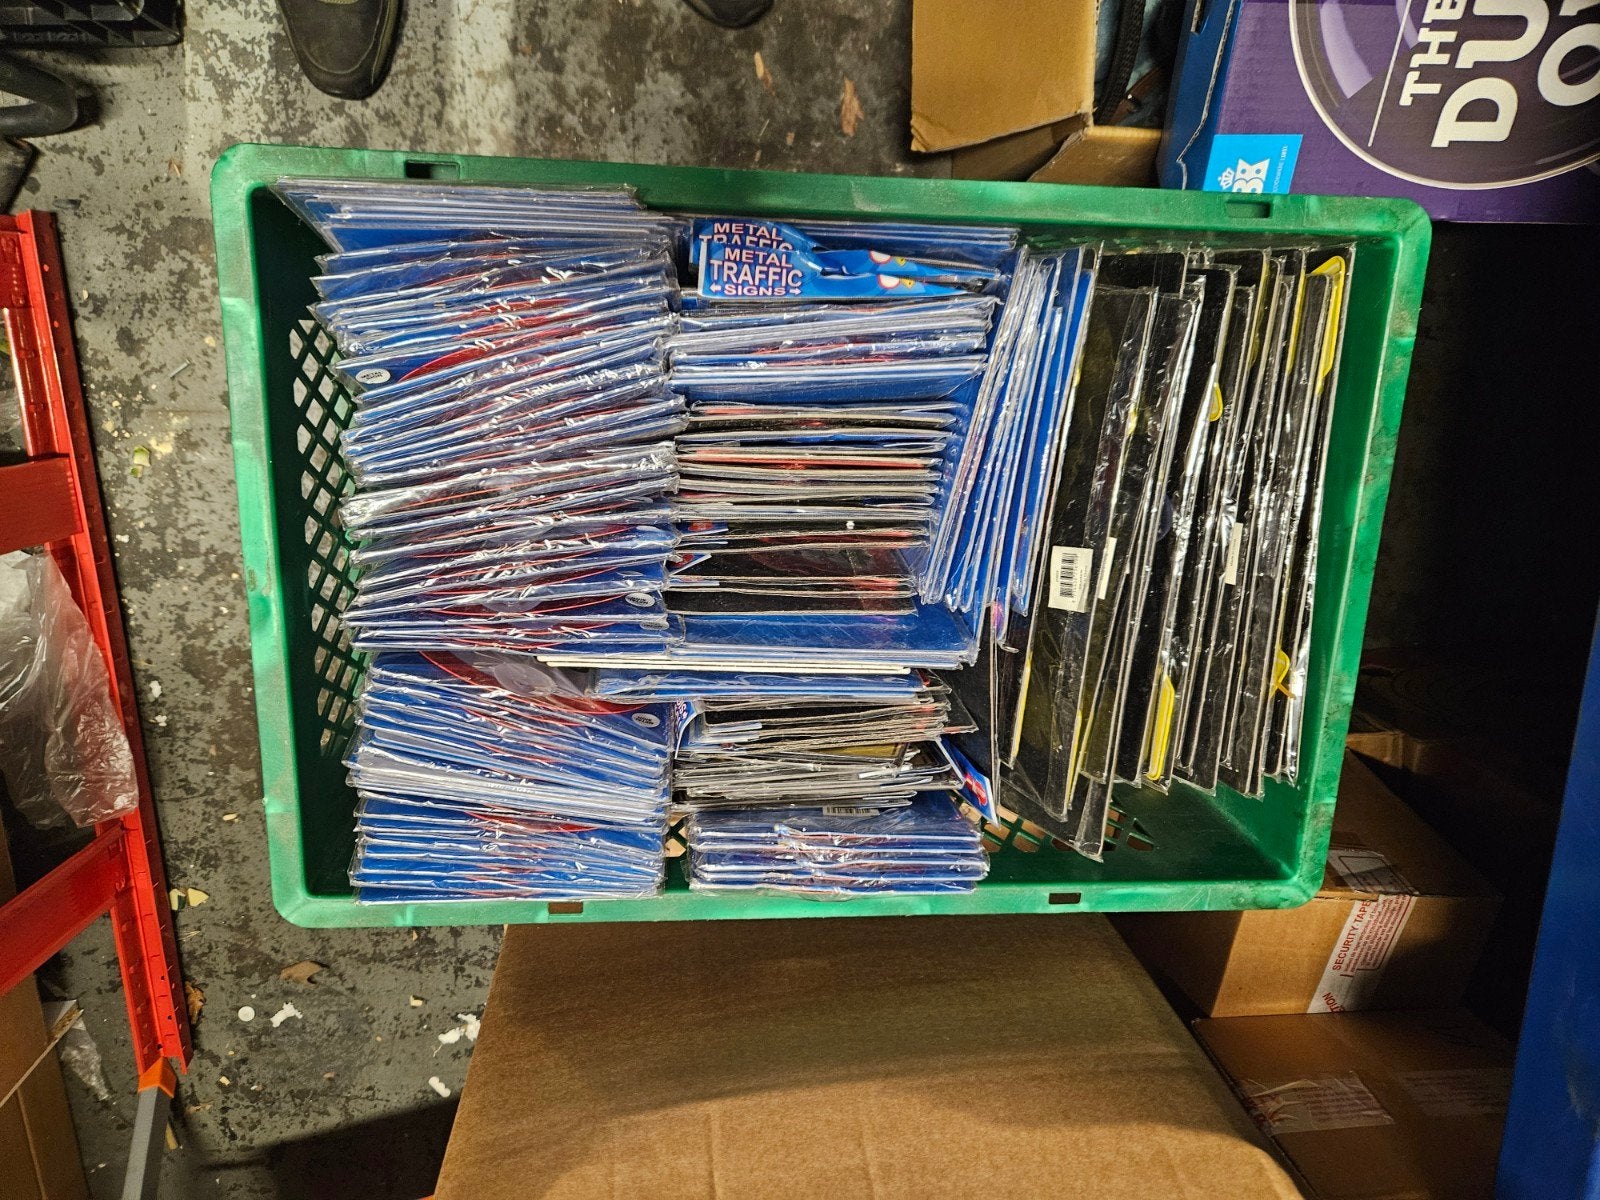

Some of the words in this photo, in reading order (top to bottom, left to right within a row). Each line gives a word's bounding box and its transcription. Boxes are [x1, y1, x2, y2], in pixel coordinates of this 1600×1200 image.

[1399, 0, 1463, 106] THE
[1537, 0, 1600, 107] O
[714, 222, 783, 241] METAL
[724, 247, 793, 268] METAL
[709, 259, 803, 288] TRAFFIC
[724, 283, 786, 296] SIGNS
[1332, 925, 1359, 971] SECURITY
[1354, 900, 1372, 924] TAPE
